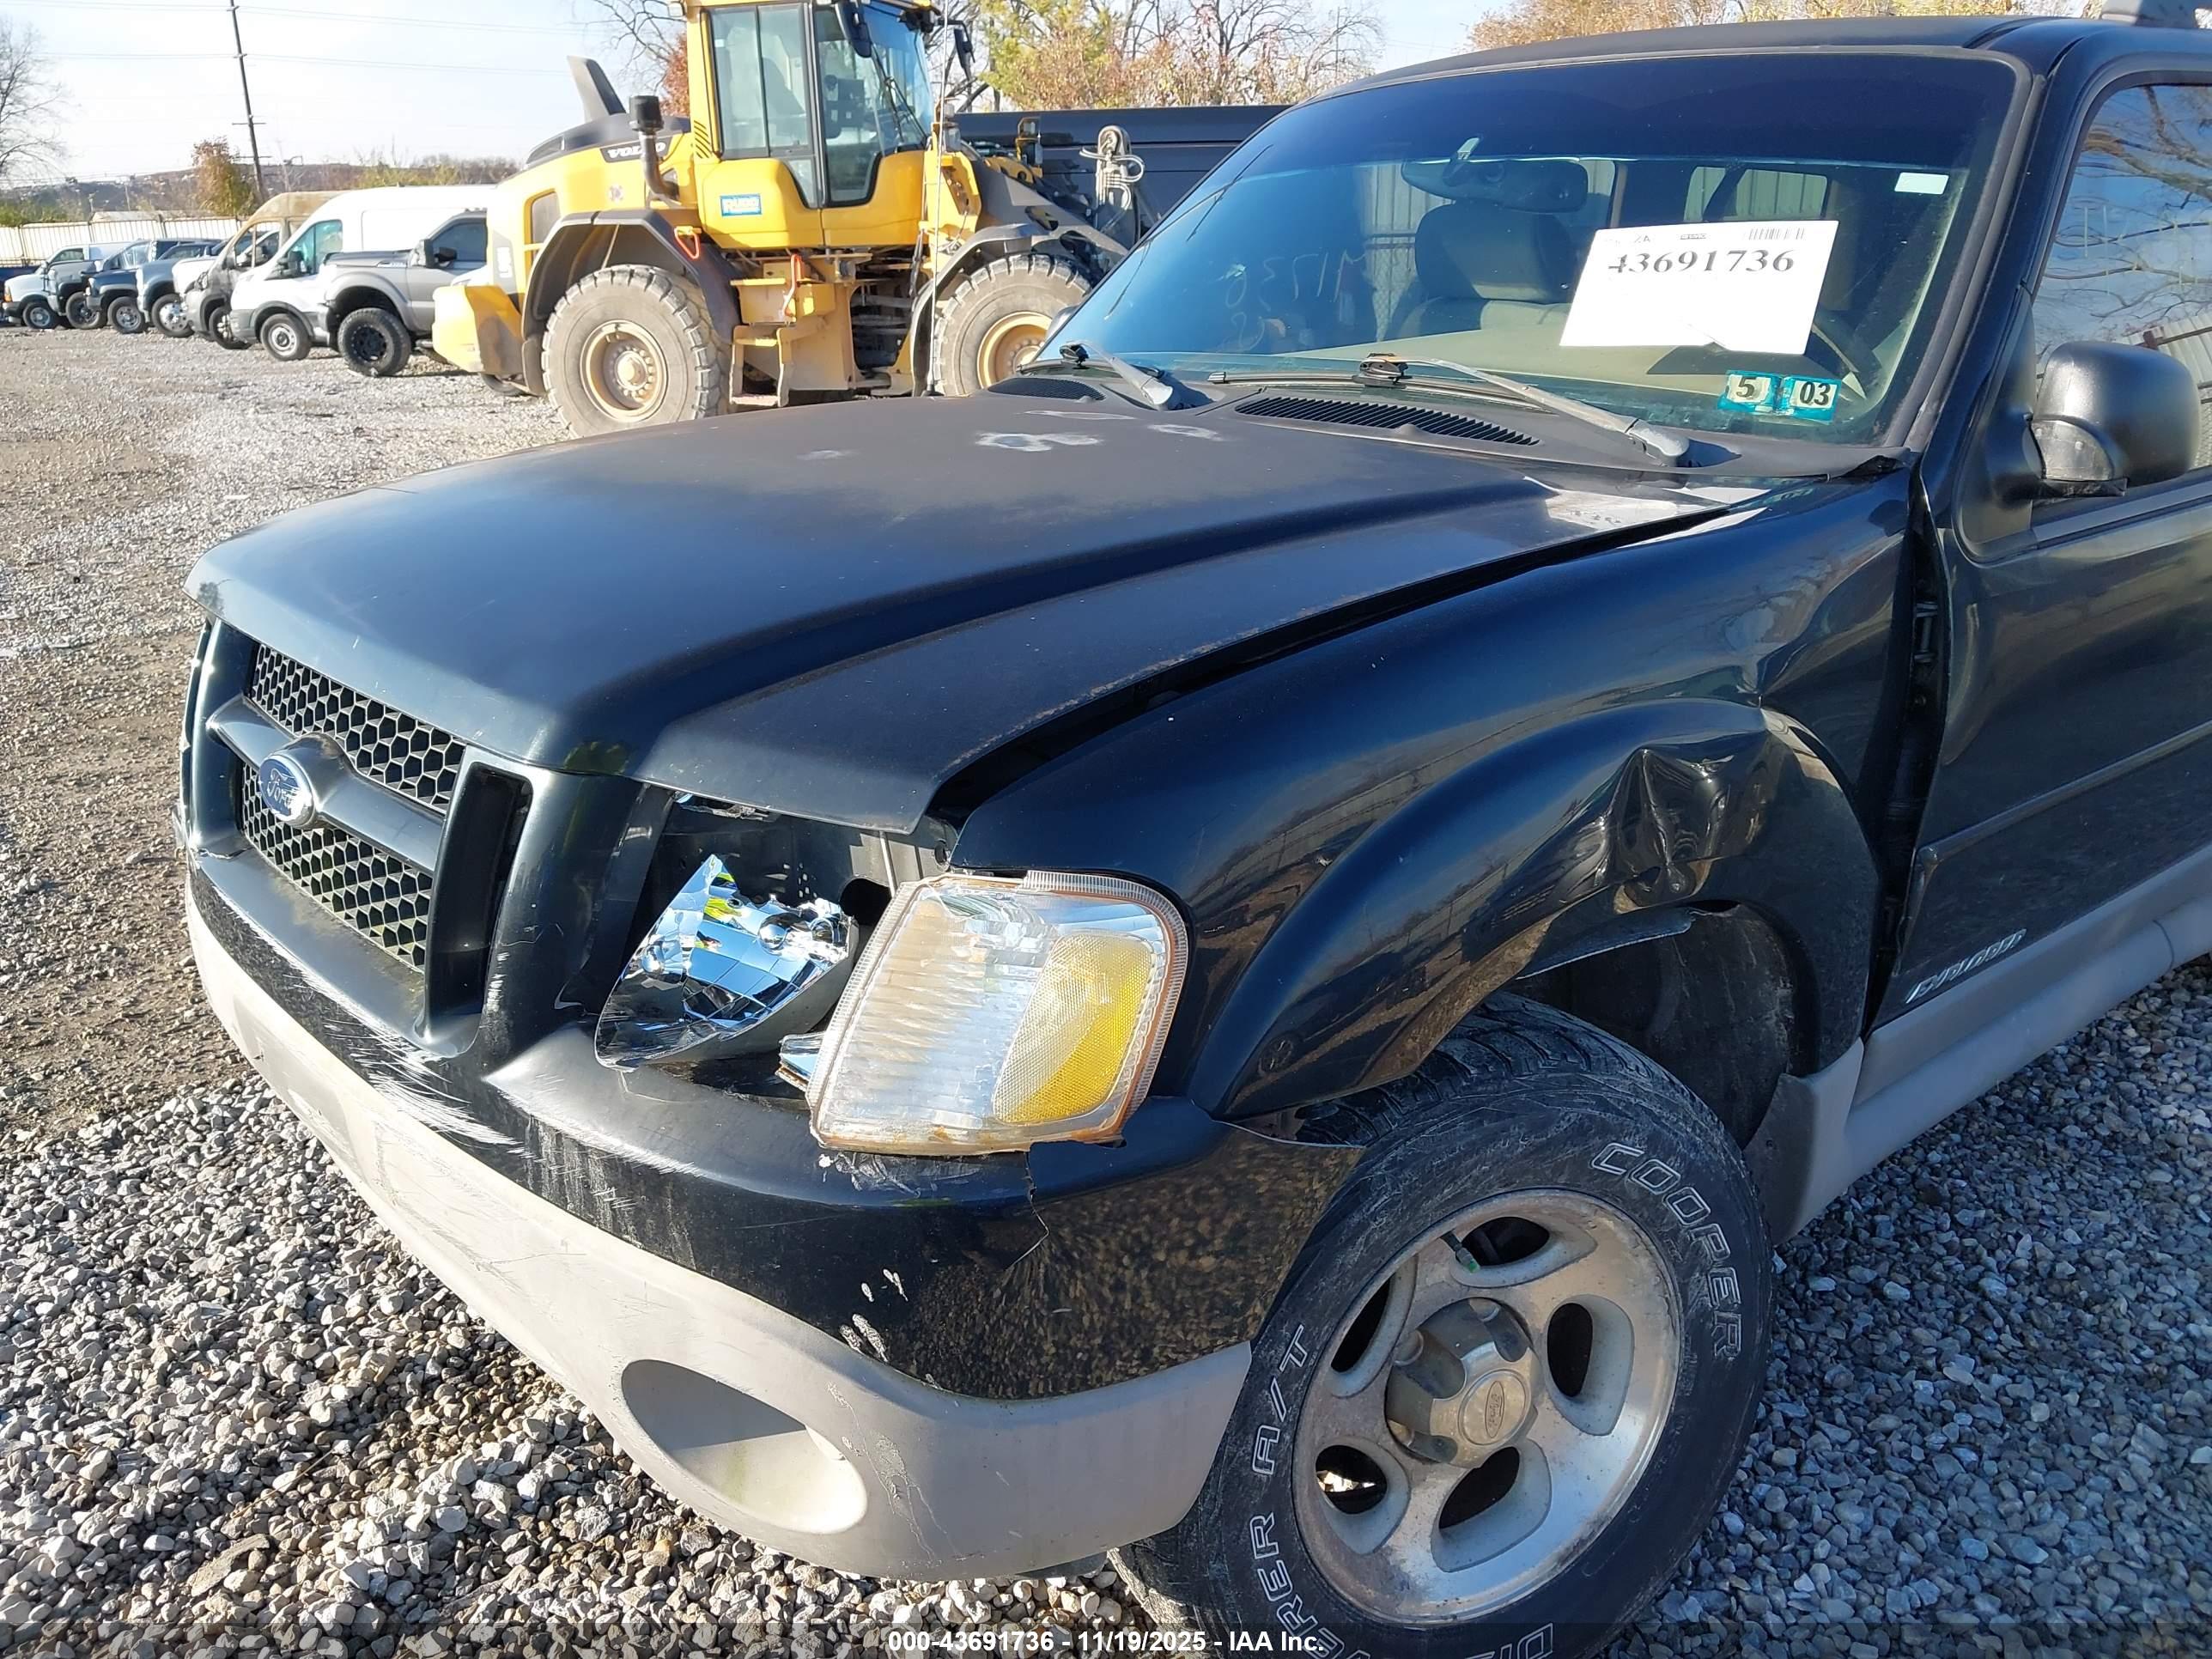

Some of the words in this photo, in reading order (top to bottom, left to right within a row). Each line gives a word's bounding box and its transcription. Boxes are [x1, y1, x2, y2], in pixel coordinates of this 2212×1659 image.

[607, 142, 666, 159] VOLO
[1608, 249, 1795, 273] 43691736
[1735, 376, 1758, 398] 5
[1799, 380, 1831, 406] 03
[1591, 1142, 1742, 1358] COOPER
[1252, 1324, 1306, 1476] A/T
